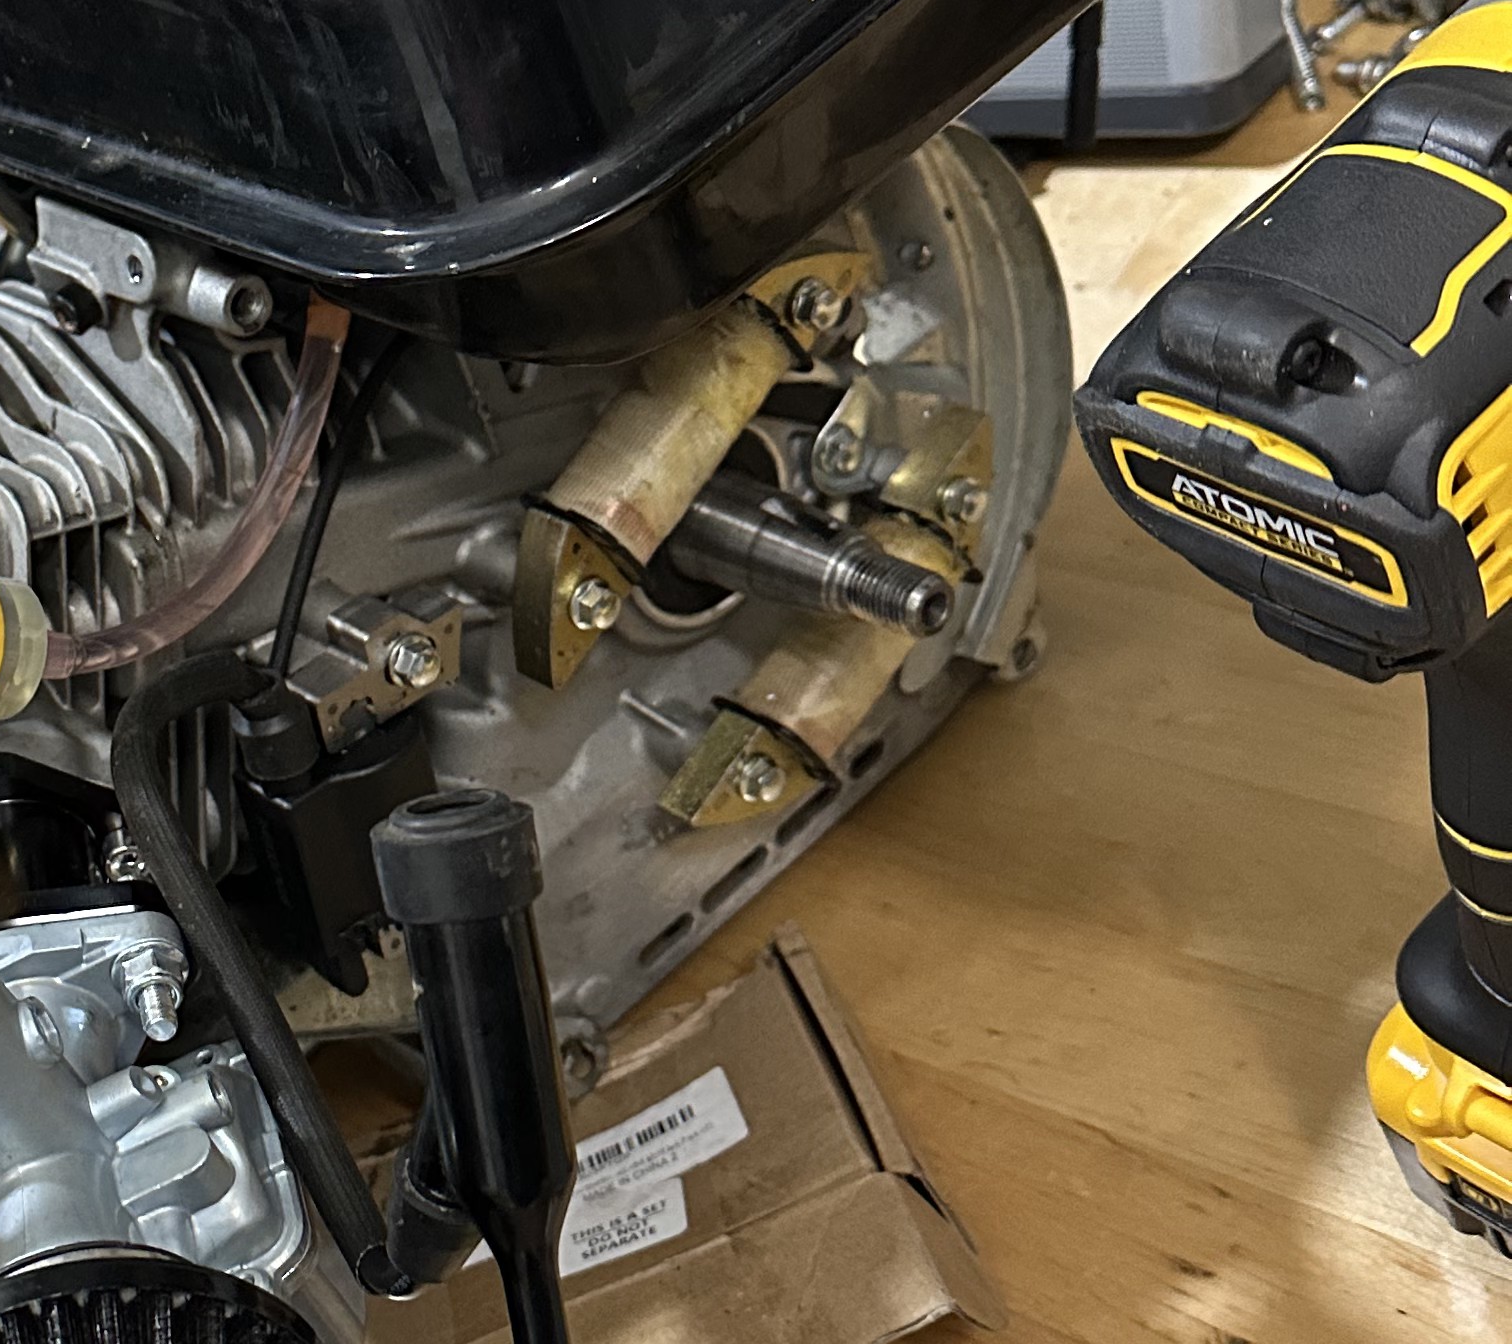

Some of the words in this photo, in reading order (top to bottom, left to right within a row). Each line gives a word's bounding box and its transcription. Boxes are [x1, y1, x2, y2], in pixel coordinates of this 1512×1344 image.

[1171, 472, 1340, 558] ATOMIC
[1181, 493, 1260, 538] COMPACT
[1267, 529, 1334, 567] SERIES
[571, 1223, 605, 1241] THIS
[609, 1217, 622, 1230] IS
[627, 1211, 638, 1221] A
[642, 1199, 666, 1216] SET
[589, 1232, 612, 1248] DO
[617, 1218, 648, 1238] NOT
[581, 1224, 657, 1260] SEPARATE
